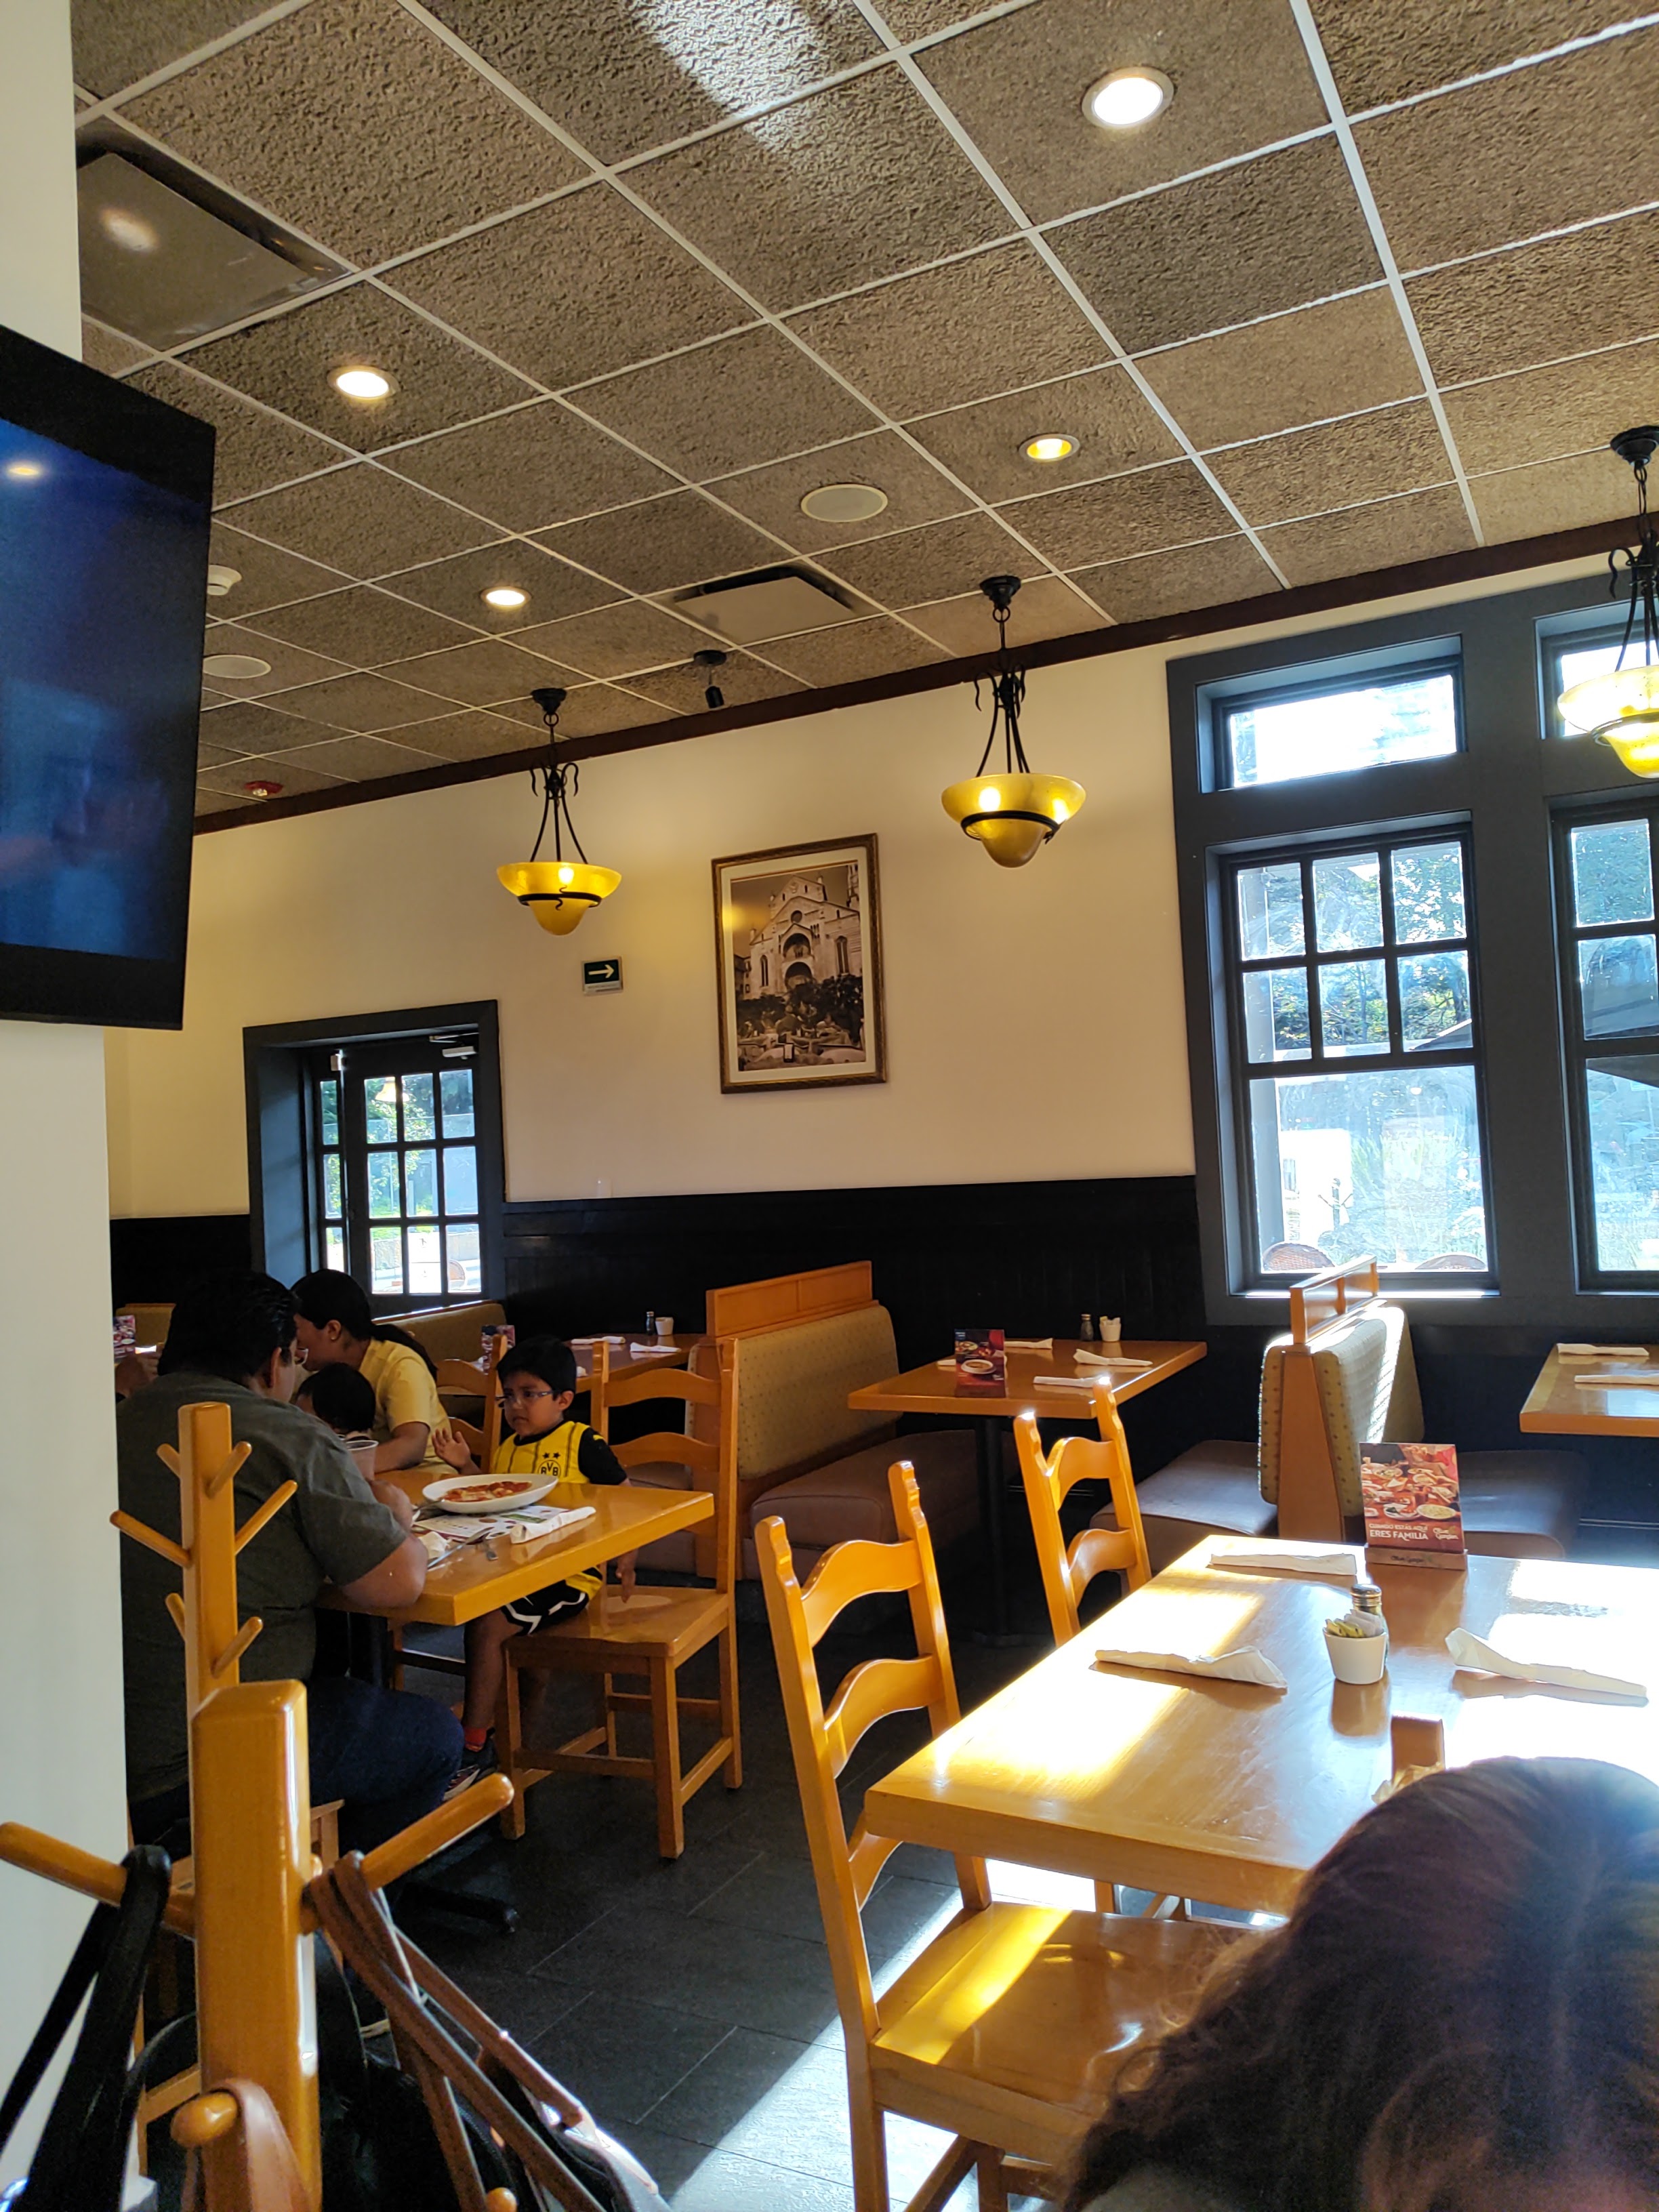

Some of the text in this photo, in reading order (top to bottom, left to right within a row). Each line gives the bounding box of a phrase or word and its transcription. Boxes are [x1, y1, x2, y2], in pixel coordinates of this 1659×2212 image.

[541, 1462, 558, 1476] BVB
[1370, 1530, 1429, 1541] ERES FAMILIA
